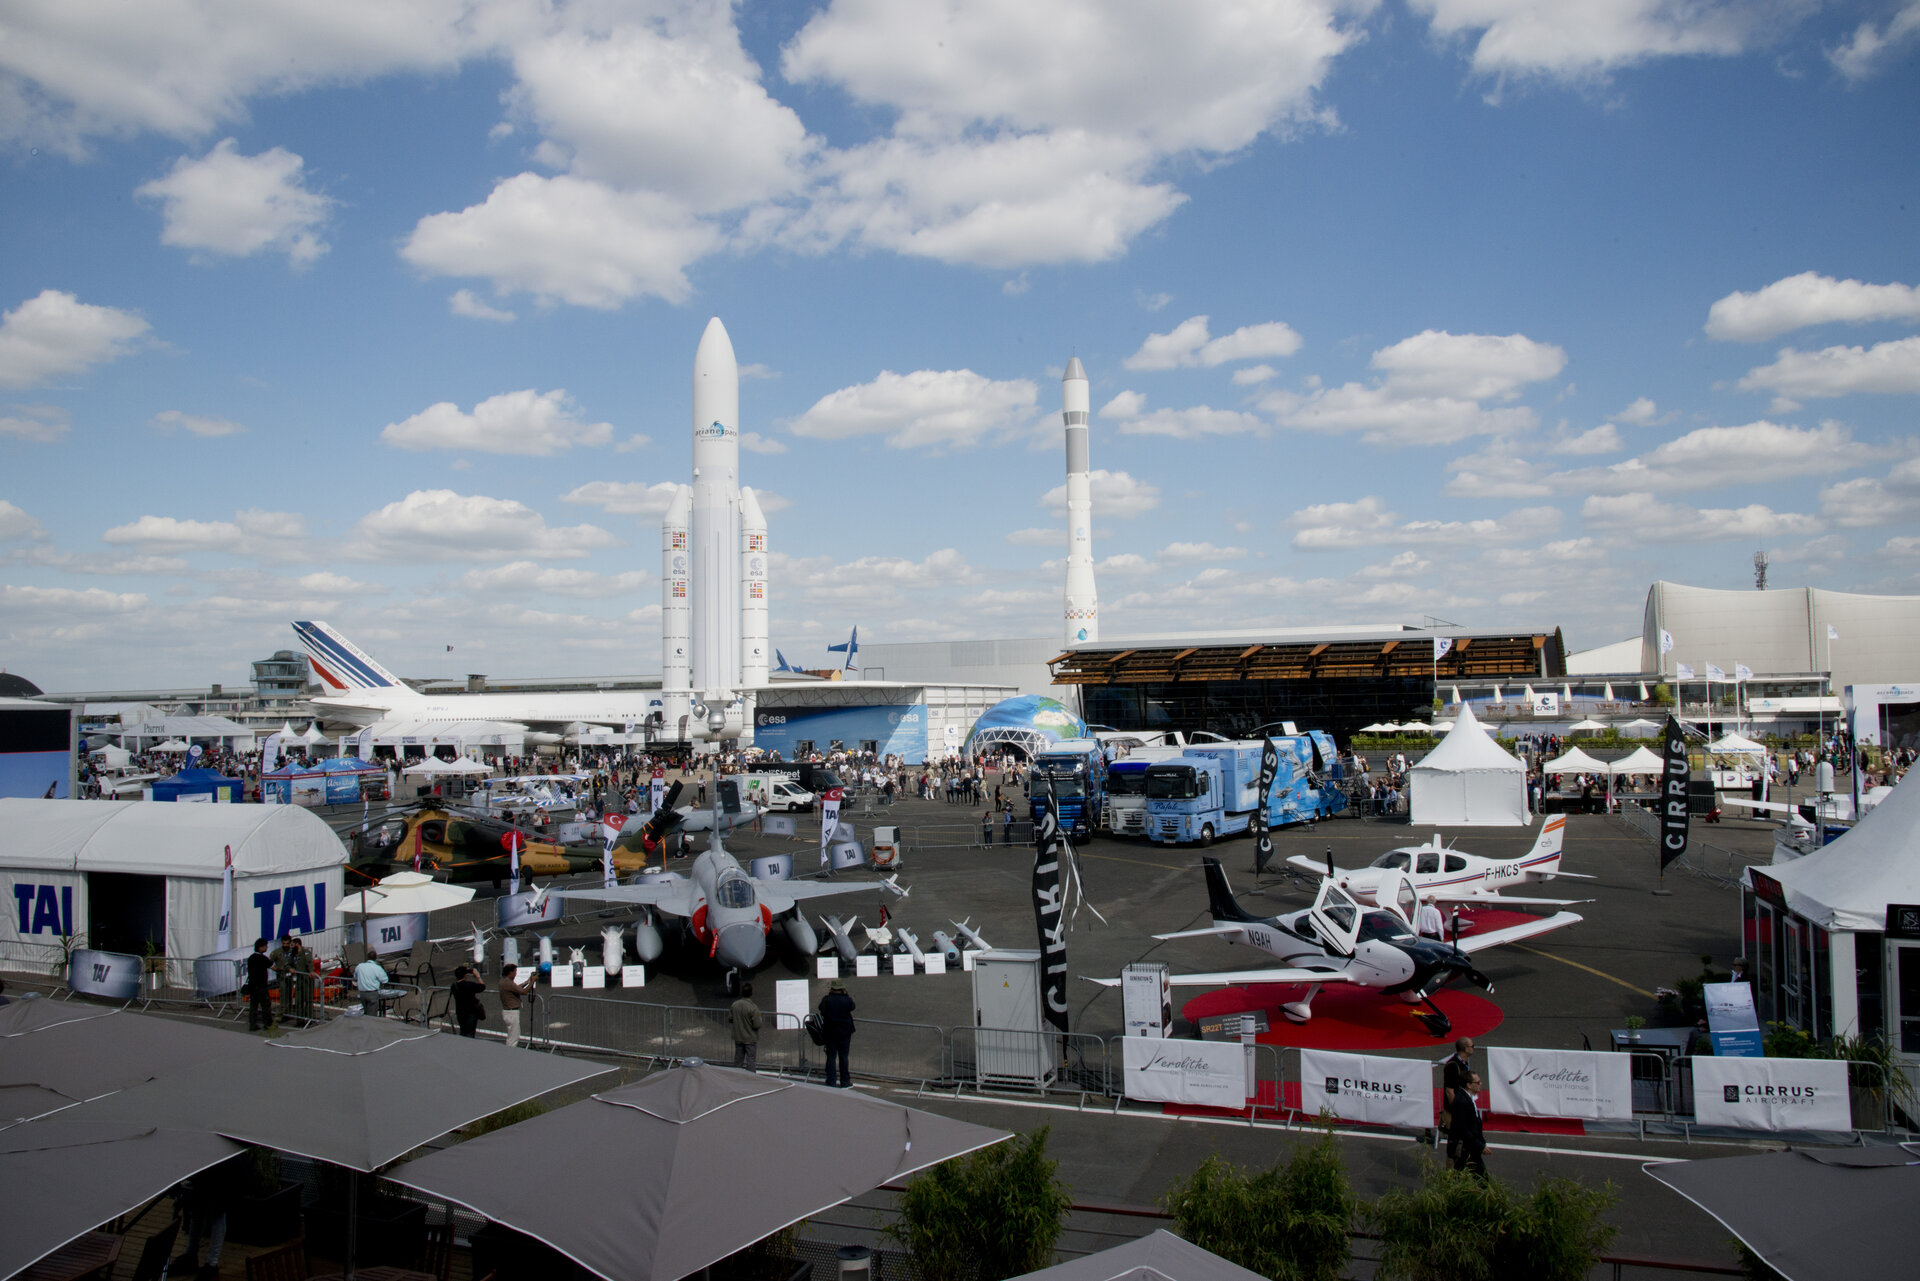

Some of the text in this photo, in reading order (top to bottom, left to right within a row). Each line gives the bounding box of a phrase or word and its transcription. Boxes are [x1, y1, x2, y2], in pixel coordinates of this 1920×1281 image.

[768, 715, 786, 724] esa
[900, 714, 919, 722] esa
[143, 723, 166, 733] Parrot
[1665, 739, 1687, 850] CIRRUS
[1260, 751, 1278, 852] CIRRUS
[845, 849, 856, 860] TAI
[768, 863, 780, 875] TAI
[1484, 863, 1519, 881] F-HKCS
[14, 883, 73, 936] TAI
[254, 882, 326, 941] TAI
[381, 925, 401, 943] TAI
[1248, 929, 1273, 950] N9AH
[92, 963, 111, 983] TAI
[1201, 1023, 1223, 1033] SR22T
[1343, 1078, 1403, 1093] CIRRUS
[1565, 1083, 1590, 1091] France
[1745, 1085, 1815, 1097] CIRRUS
[1343, 1090, 1404, 1102] AIRCRAFT
[1745, 1097, 1815, 1105] AIRCRAFT
